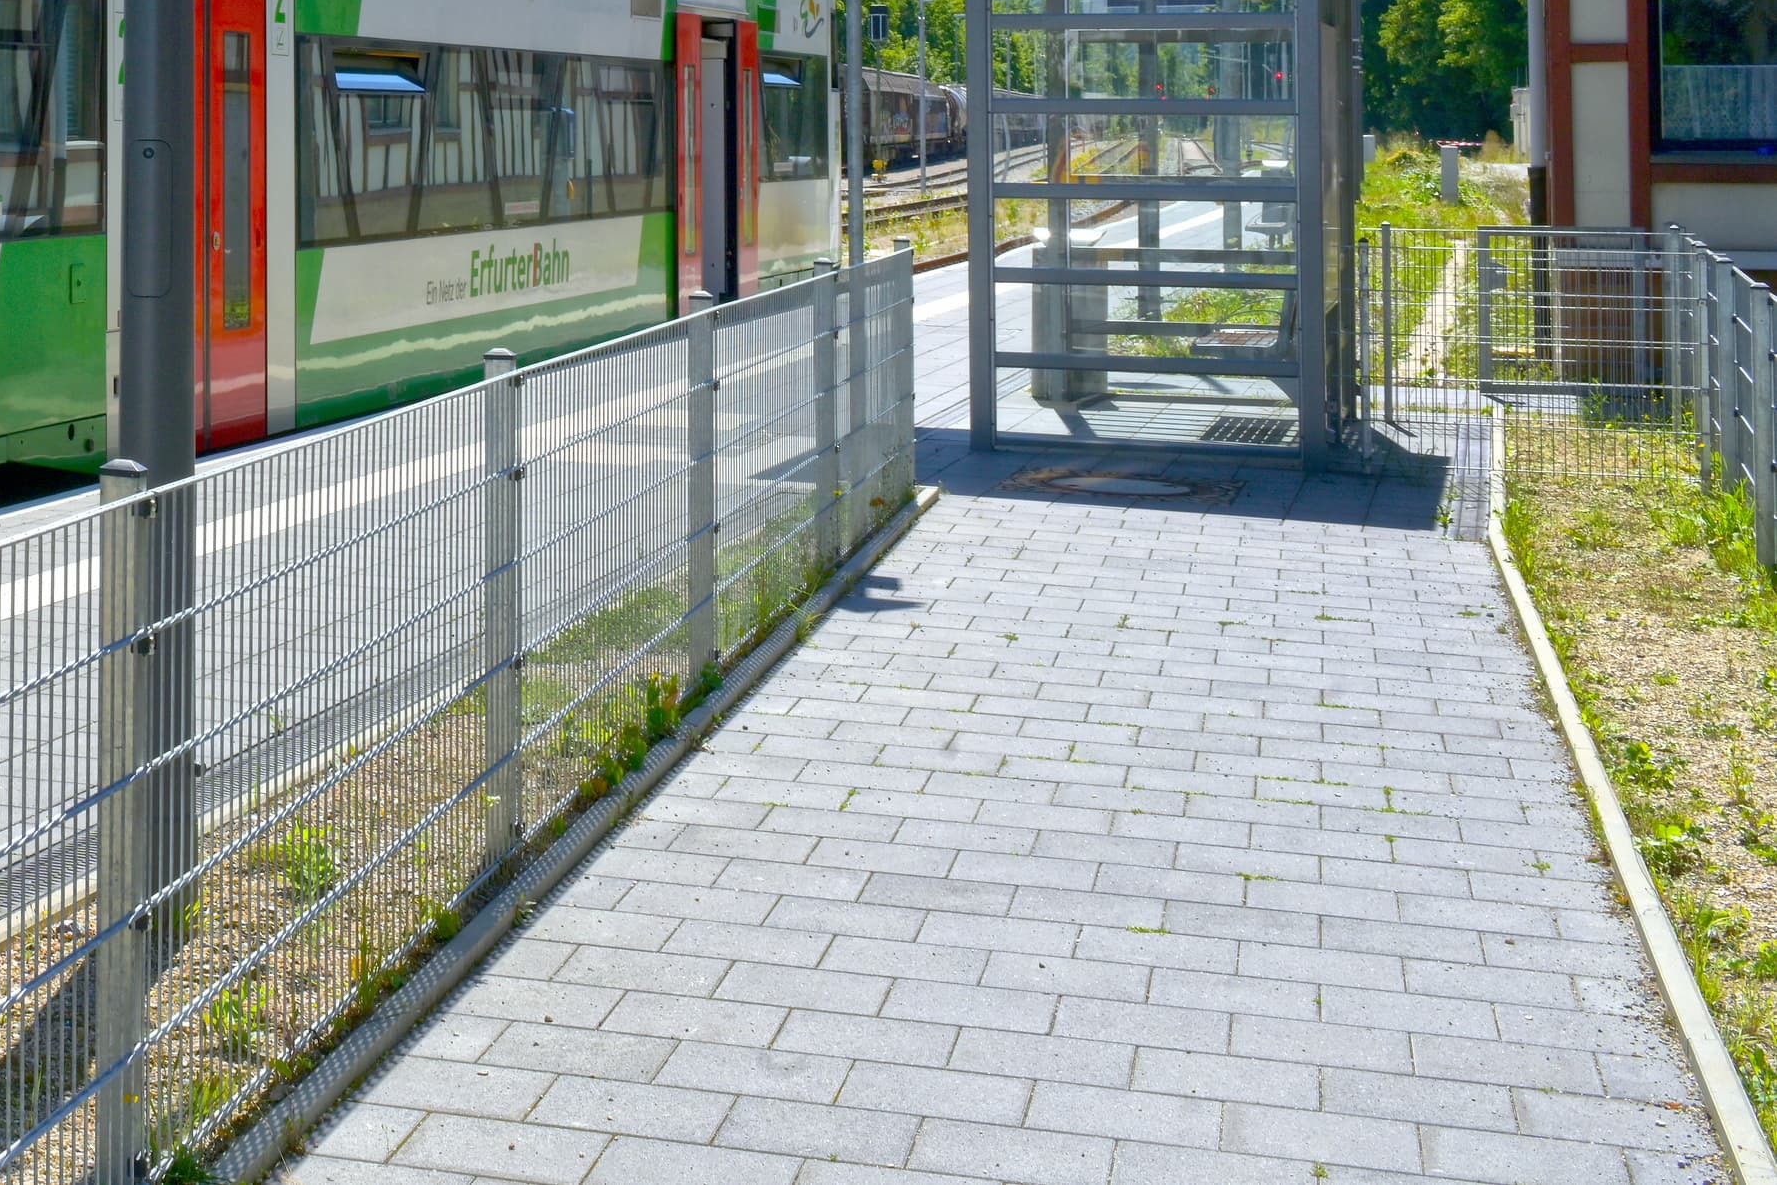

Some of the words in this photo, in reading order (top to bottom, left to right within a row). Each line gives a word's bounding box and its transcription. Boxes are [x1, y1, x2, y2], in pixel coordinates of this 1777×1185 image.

[426, 281, 438, 305] Ein
[439, 279, 454, 303] Netz
[455, 276, 467, 300] der
[470, 238, 570, 298] ErfurterBahn
